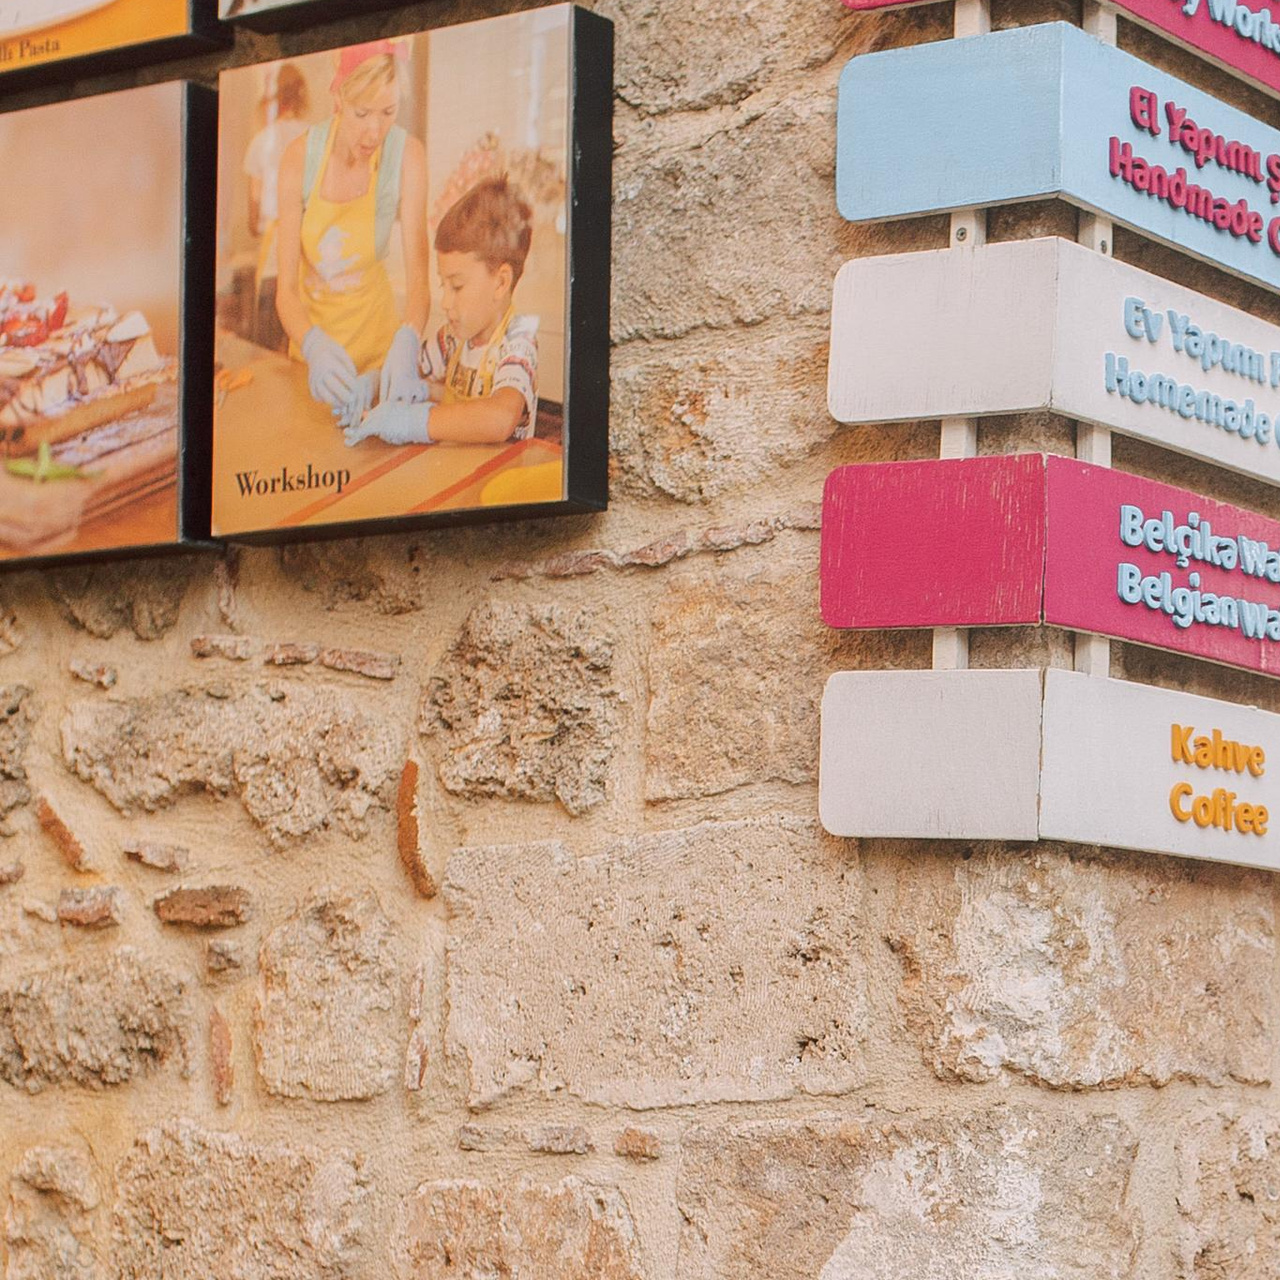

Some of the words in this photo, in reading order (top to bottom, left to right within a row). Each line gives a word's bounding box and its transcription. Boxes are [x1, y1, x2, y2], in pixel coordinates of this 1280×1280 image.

[20, 38, 61, 58] Pasta
[1129, 86, 1161, 136] El
[1165, 101, 1264, 182] Yapımı
[1109, 136, 1263, 242] Handmade
[1123, 297, 1164, 343] Ev
[1167, 309, 1266, 383] Yapımı
[1105, 352, 1271, 445] Homemade
[235, 464, 351, 498] Workshop
[1120, 504, 1238, 570] Belçika
[1117, 562, 1239, 629] Belgian
[1171, 723, 1265, 777] Kahve
[1169, 782, 1269, 837] Coffee
